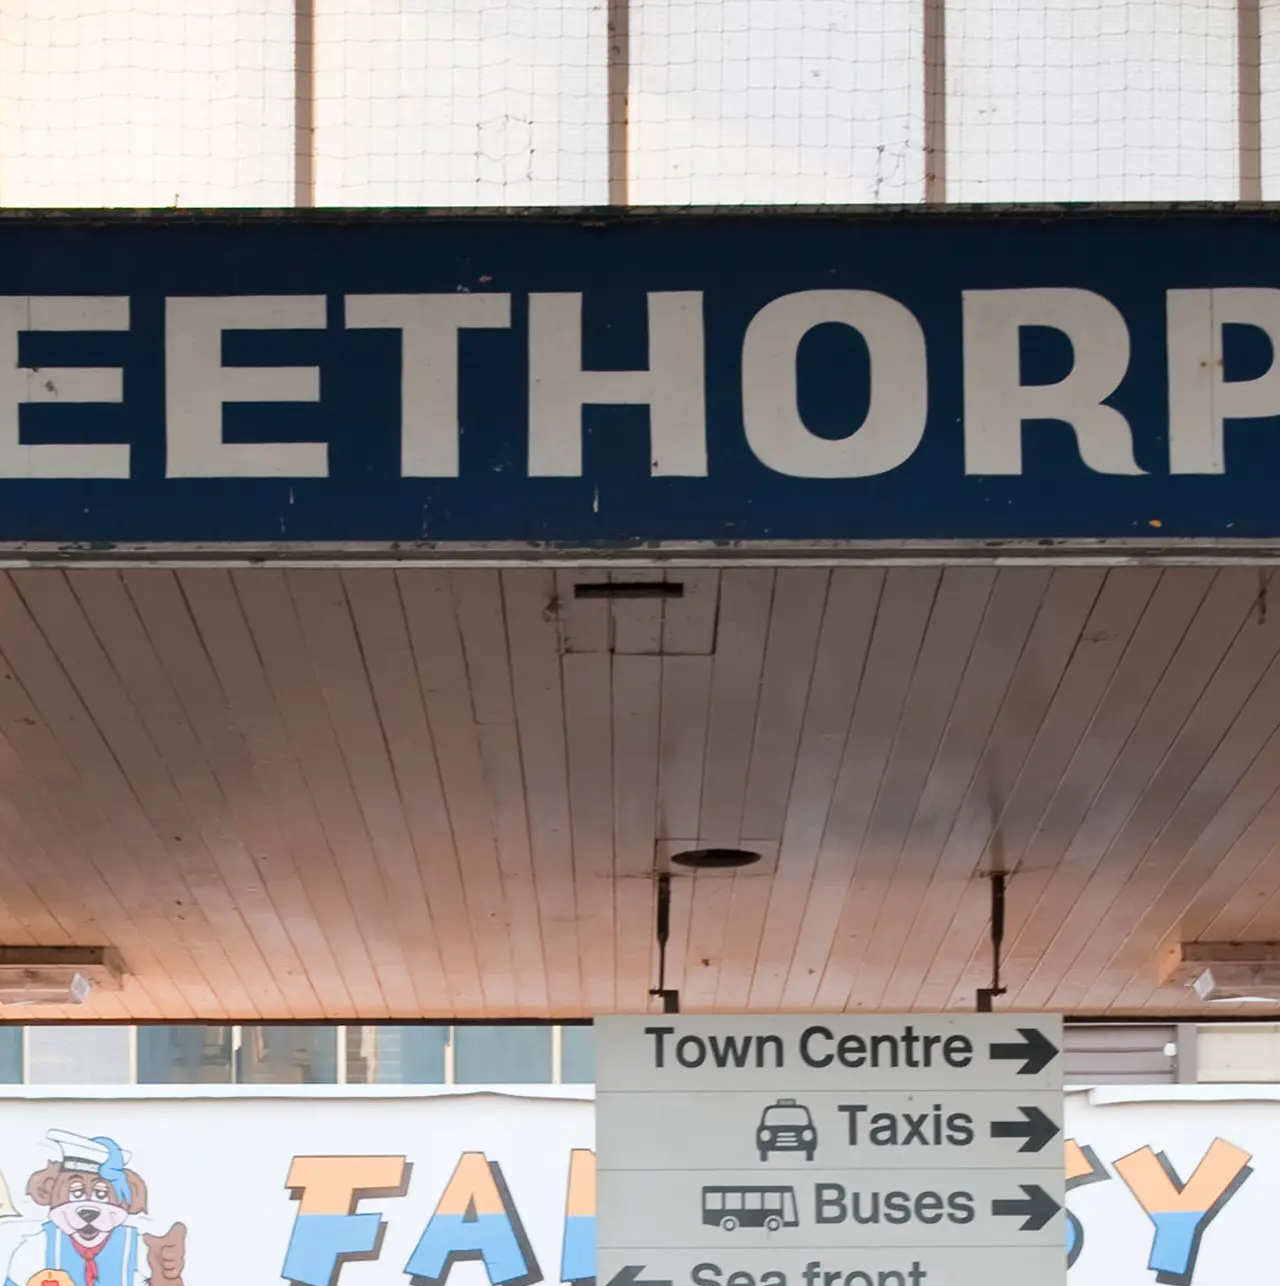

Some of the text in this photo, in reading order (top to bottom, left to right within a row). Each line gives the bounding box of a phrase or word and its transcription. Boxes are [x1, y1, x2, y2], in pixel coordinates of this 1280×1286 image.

[644, 1025, 974, 1069] Town Centre
[837, 1103, 975, 1147] Taxis
[815, 1182, 975, 1225] Buses
